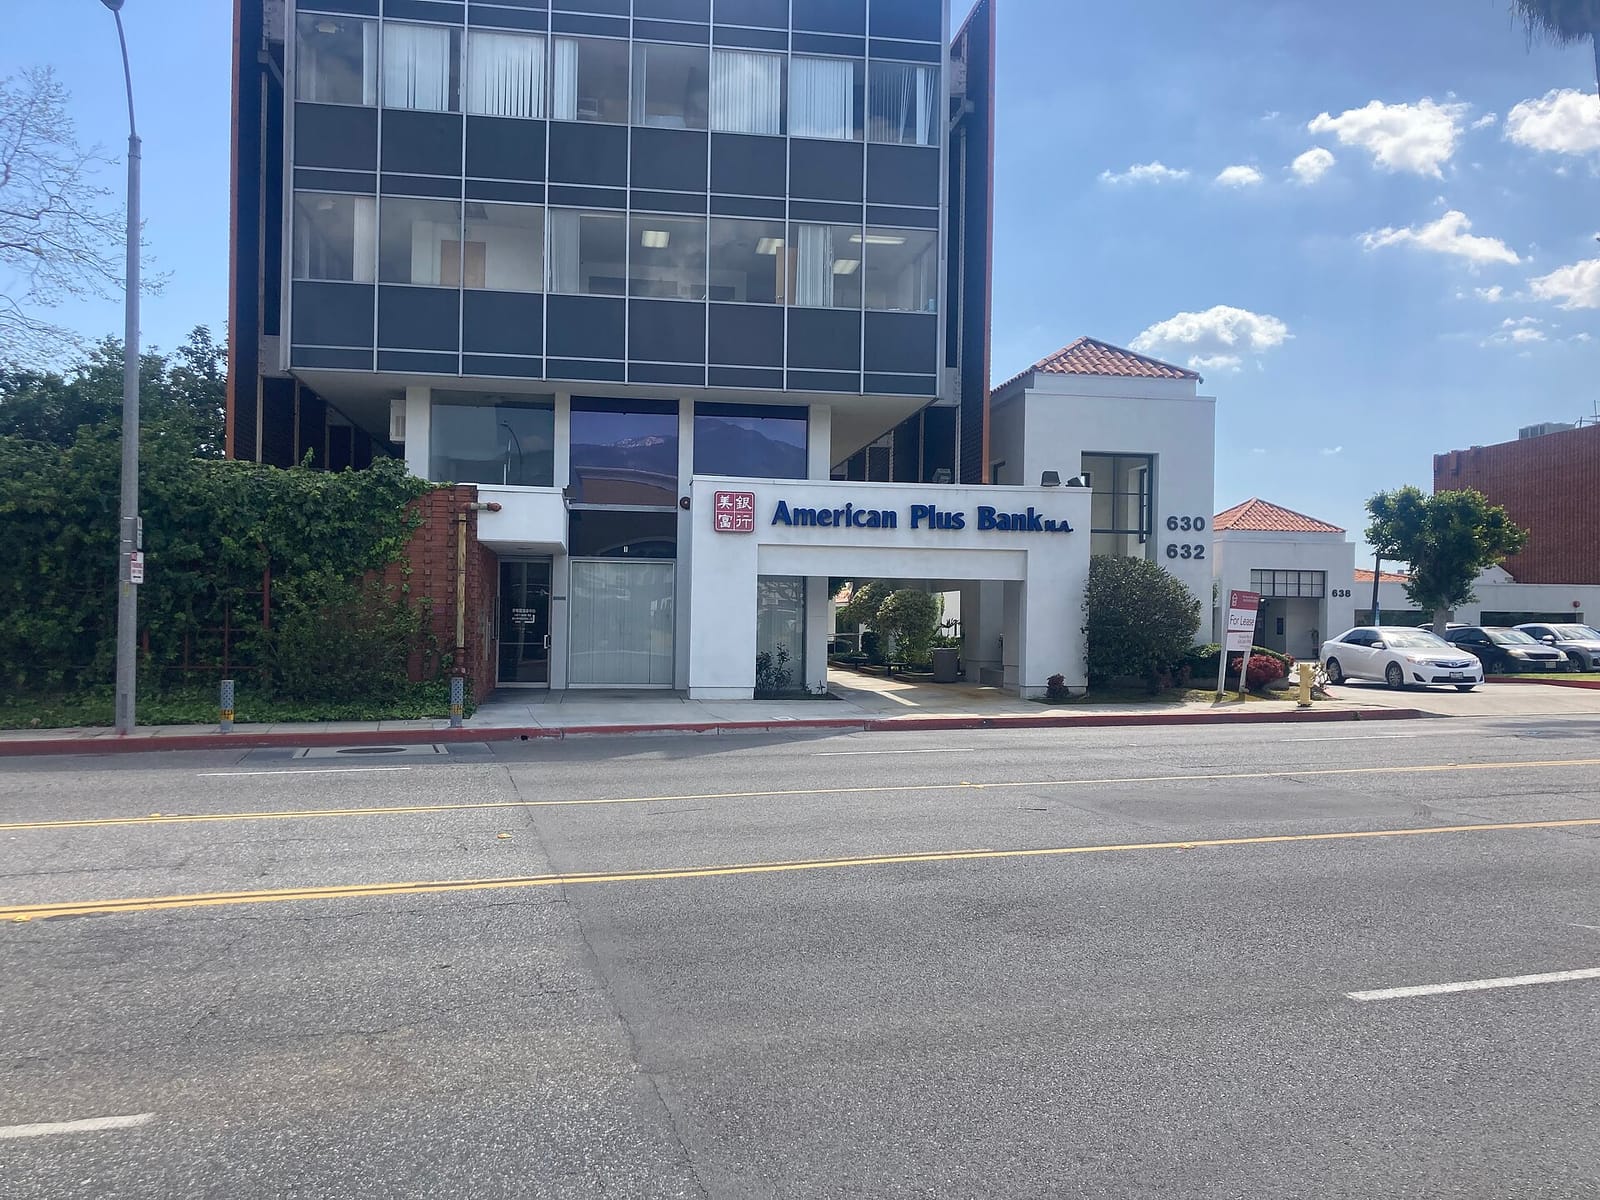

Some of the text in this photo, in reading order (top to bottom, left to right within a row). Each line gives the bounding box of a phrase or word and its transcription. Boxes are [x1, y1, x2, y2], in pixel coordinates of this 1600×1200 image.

[771, 500, 898, 530] American
[911, 504, 966, 531] Plus
[977, 505, 1043, 532] Bank
[1166, 515, 1206, 532] 630
[1166, 543, 1206, 560] 632
[1331, 589, 1352, 598] 638
[1230, 614, 1255, 627] For Lease
